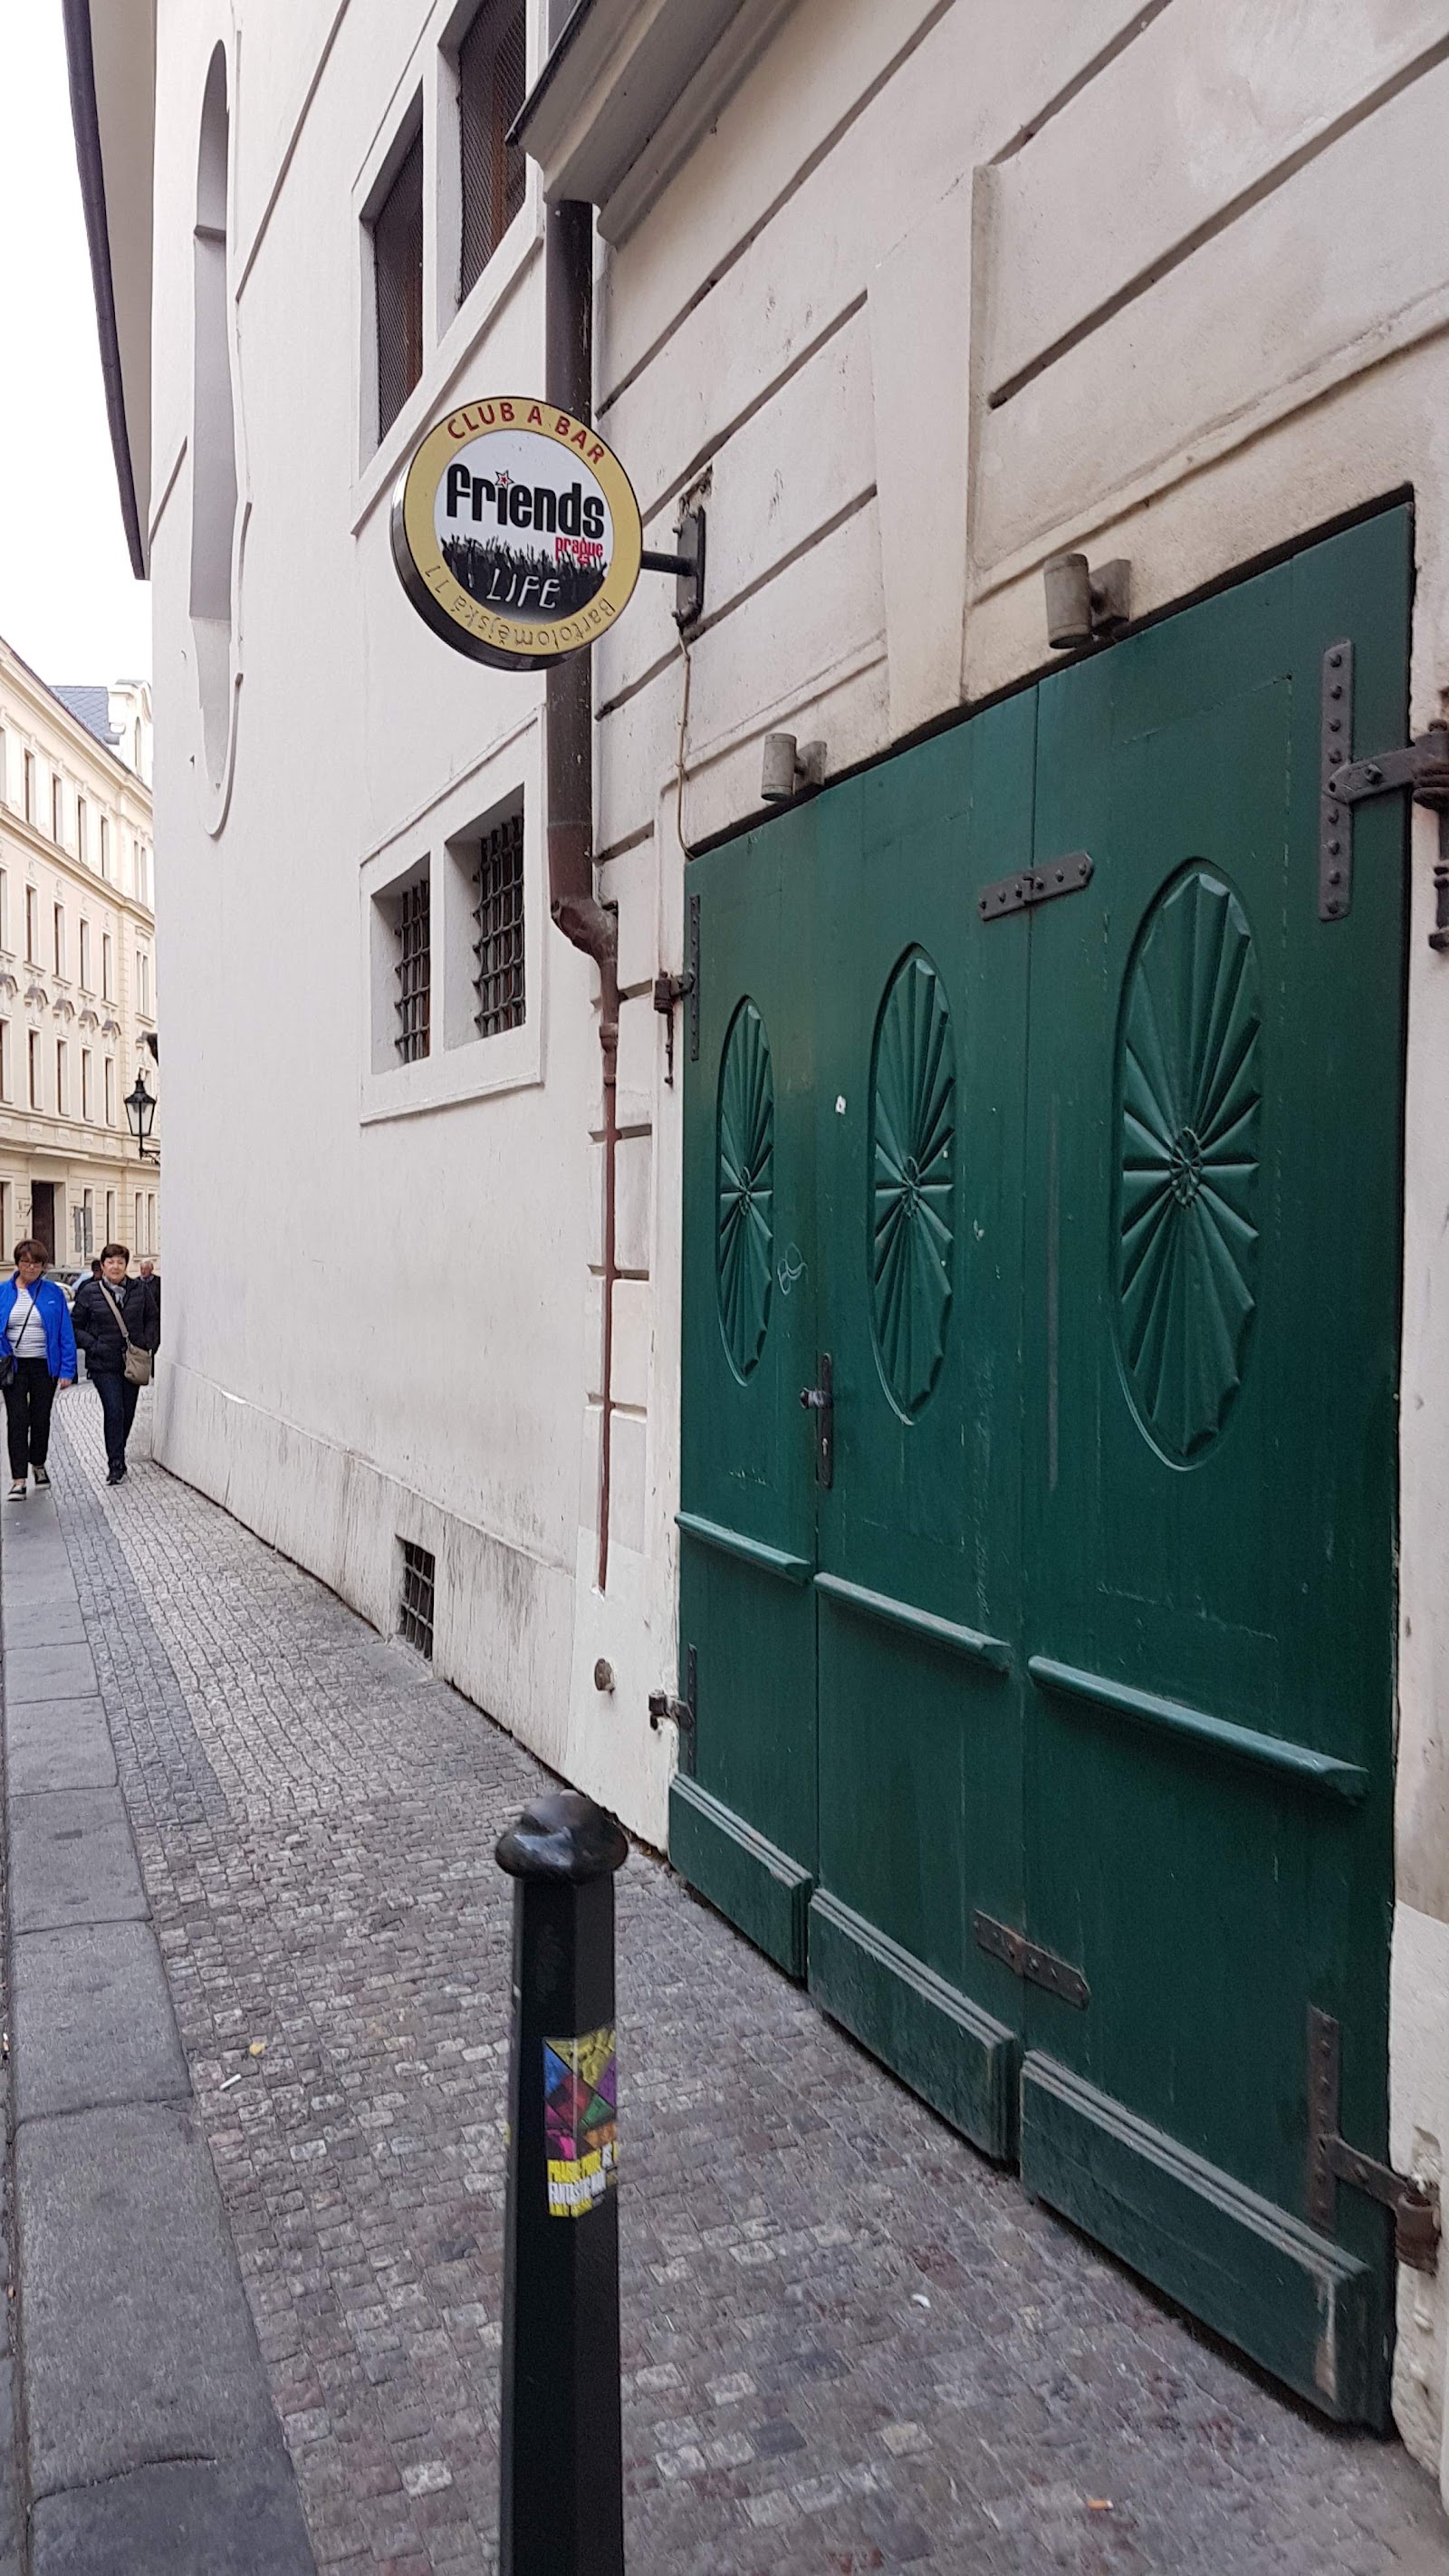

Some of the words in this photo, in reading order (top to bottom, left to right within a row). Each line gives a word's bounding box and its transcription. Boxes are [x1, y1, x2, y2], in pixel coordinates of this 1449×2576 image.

[447, 402, 515, 439] CLUB
[527, 406, 543, 426] A
[555, 416, 606, 465] BAR
[446, 463, 605, 539] friends
[555, 535, 604, 565] prague
[424, 564, 450, 593] 11
[486, 568, 561, 609] LIFE
